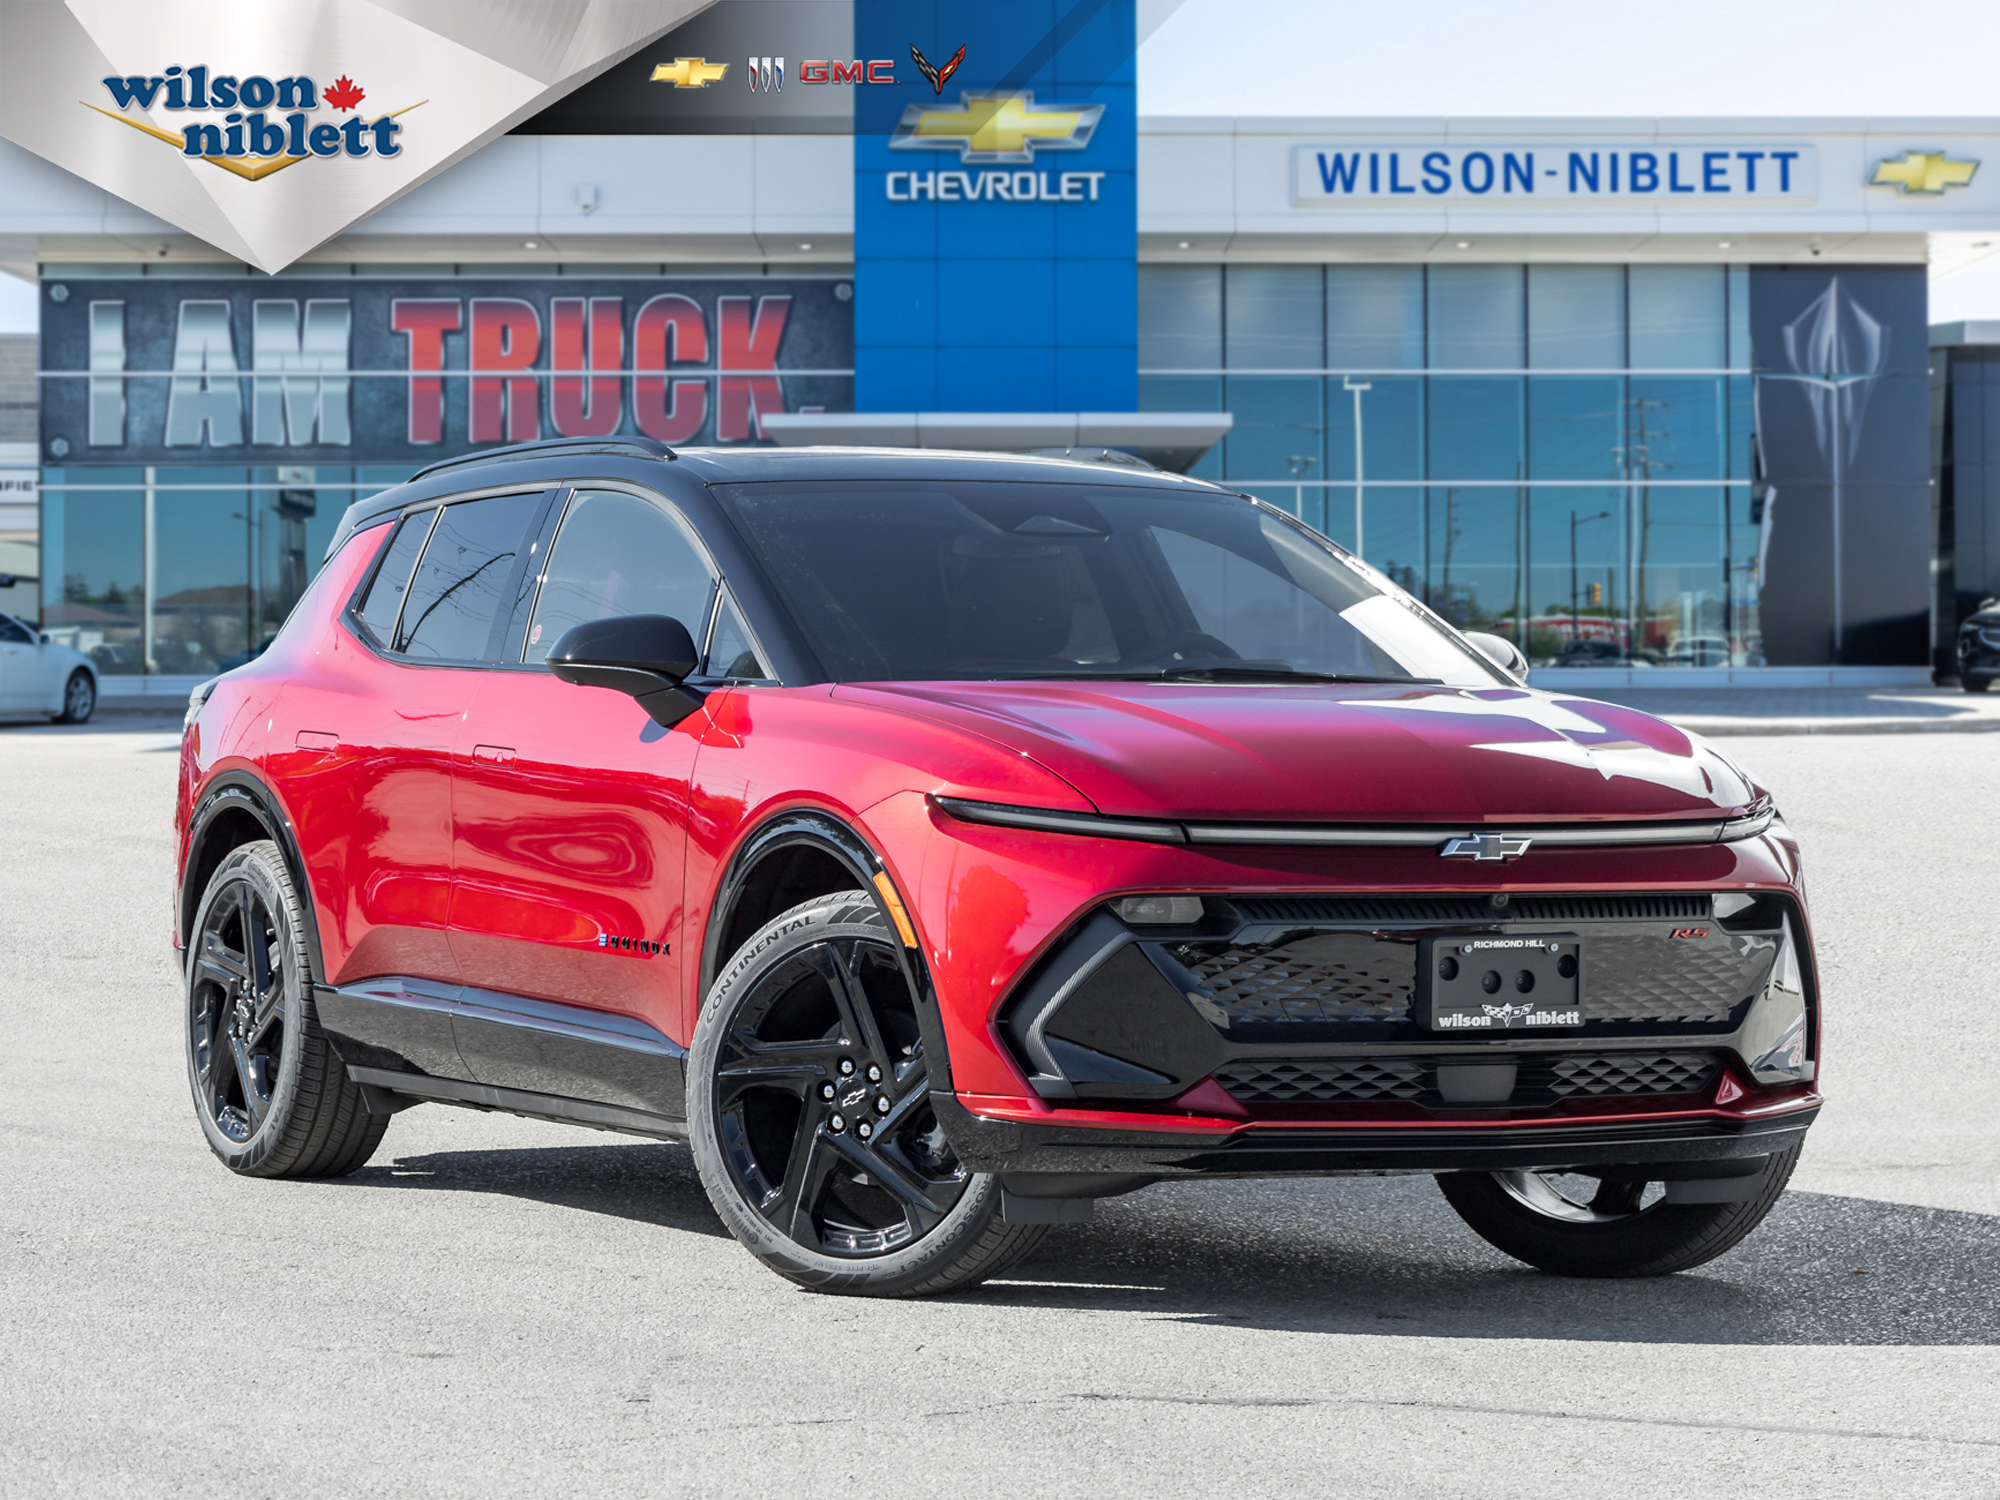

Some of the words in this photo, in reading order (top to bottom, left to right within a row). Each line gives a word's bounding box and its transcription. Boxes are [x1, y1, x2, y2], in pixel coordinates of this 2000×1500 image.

[1316, 151, 1799, 194] WILSON-NIBLETT
[886, 171, 1105, 201] CHEVROLET
[88, 300, 126, 446] I
[164, 300, 352, 446] AM
[391, 294, 826, 445] TRUCK
[598, 933, 670, 956] EQUINOX
[1473, 940, 1524, 949] RICHMOND
[1525, 940, 1546, 948] HILL
[1668, 928, 1709, 939] RS
[706, 916, 816, 1024] CONTINENTAL
[1438, 1013, 1491, 1027] wilson
[1525, 1011, 1580, 1026] niblett
